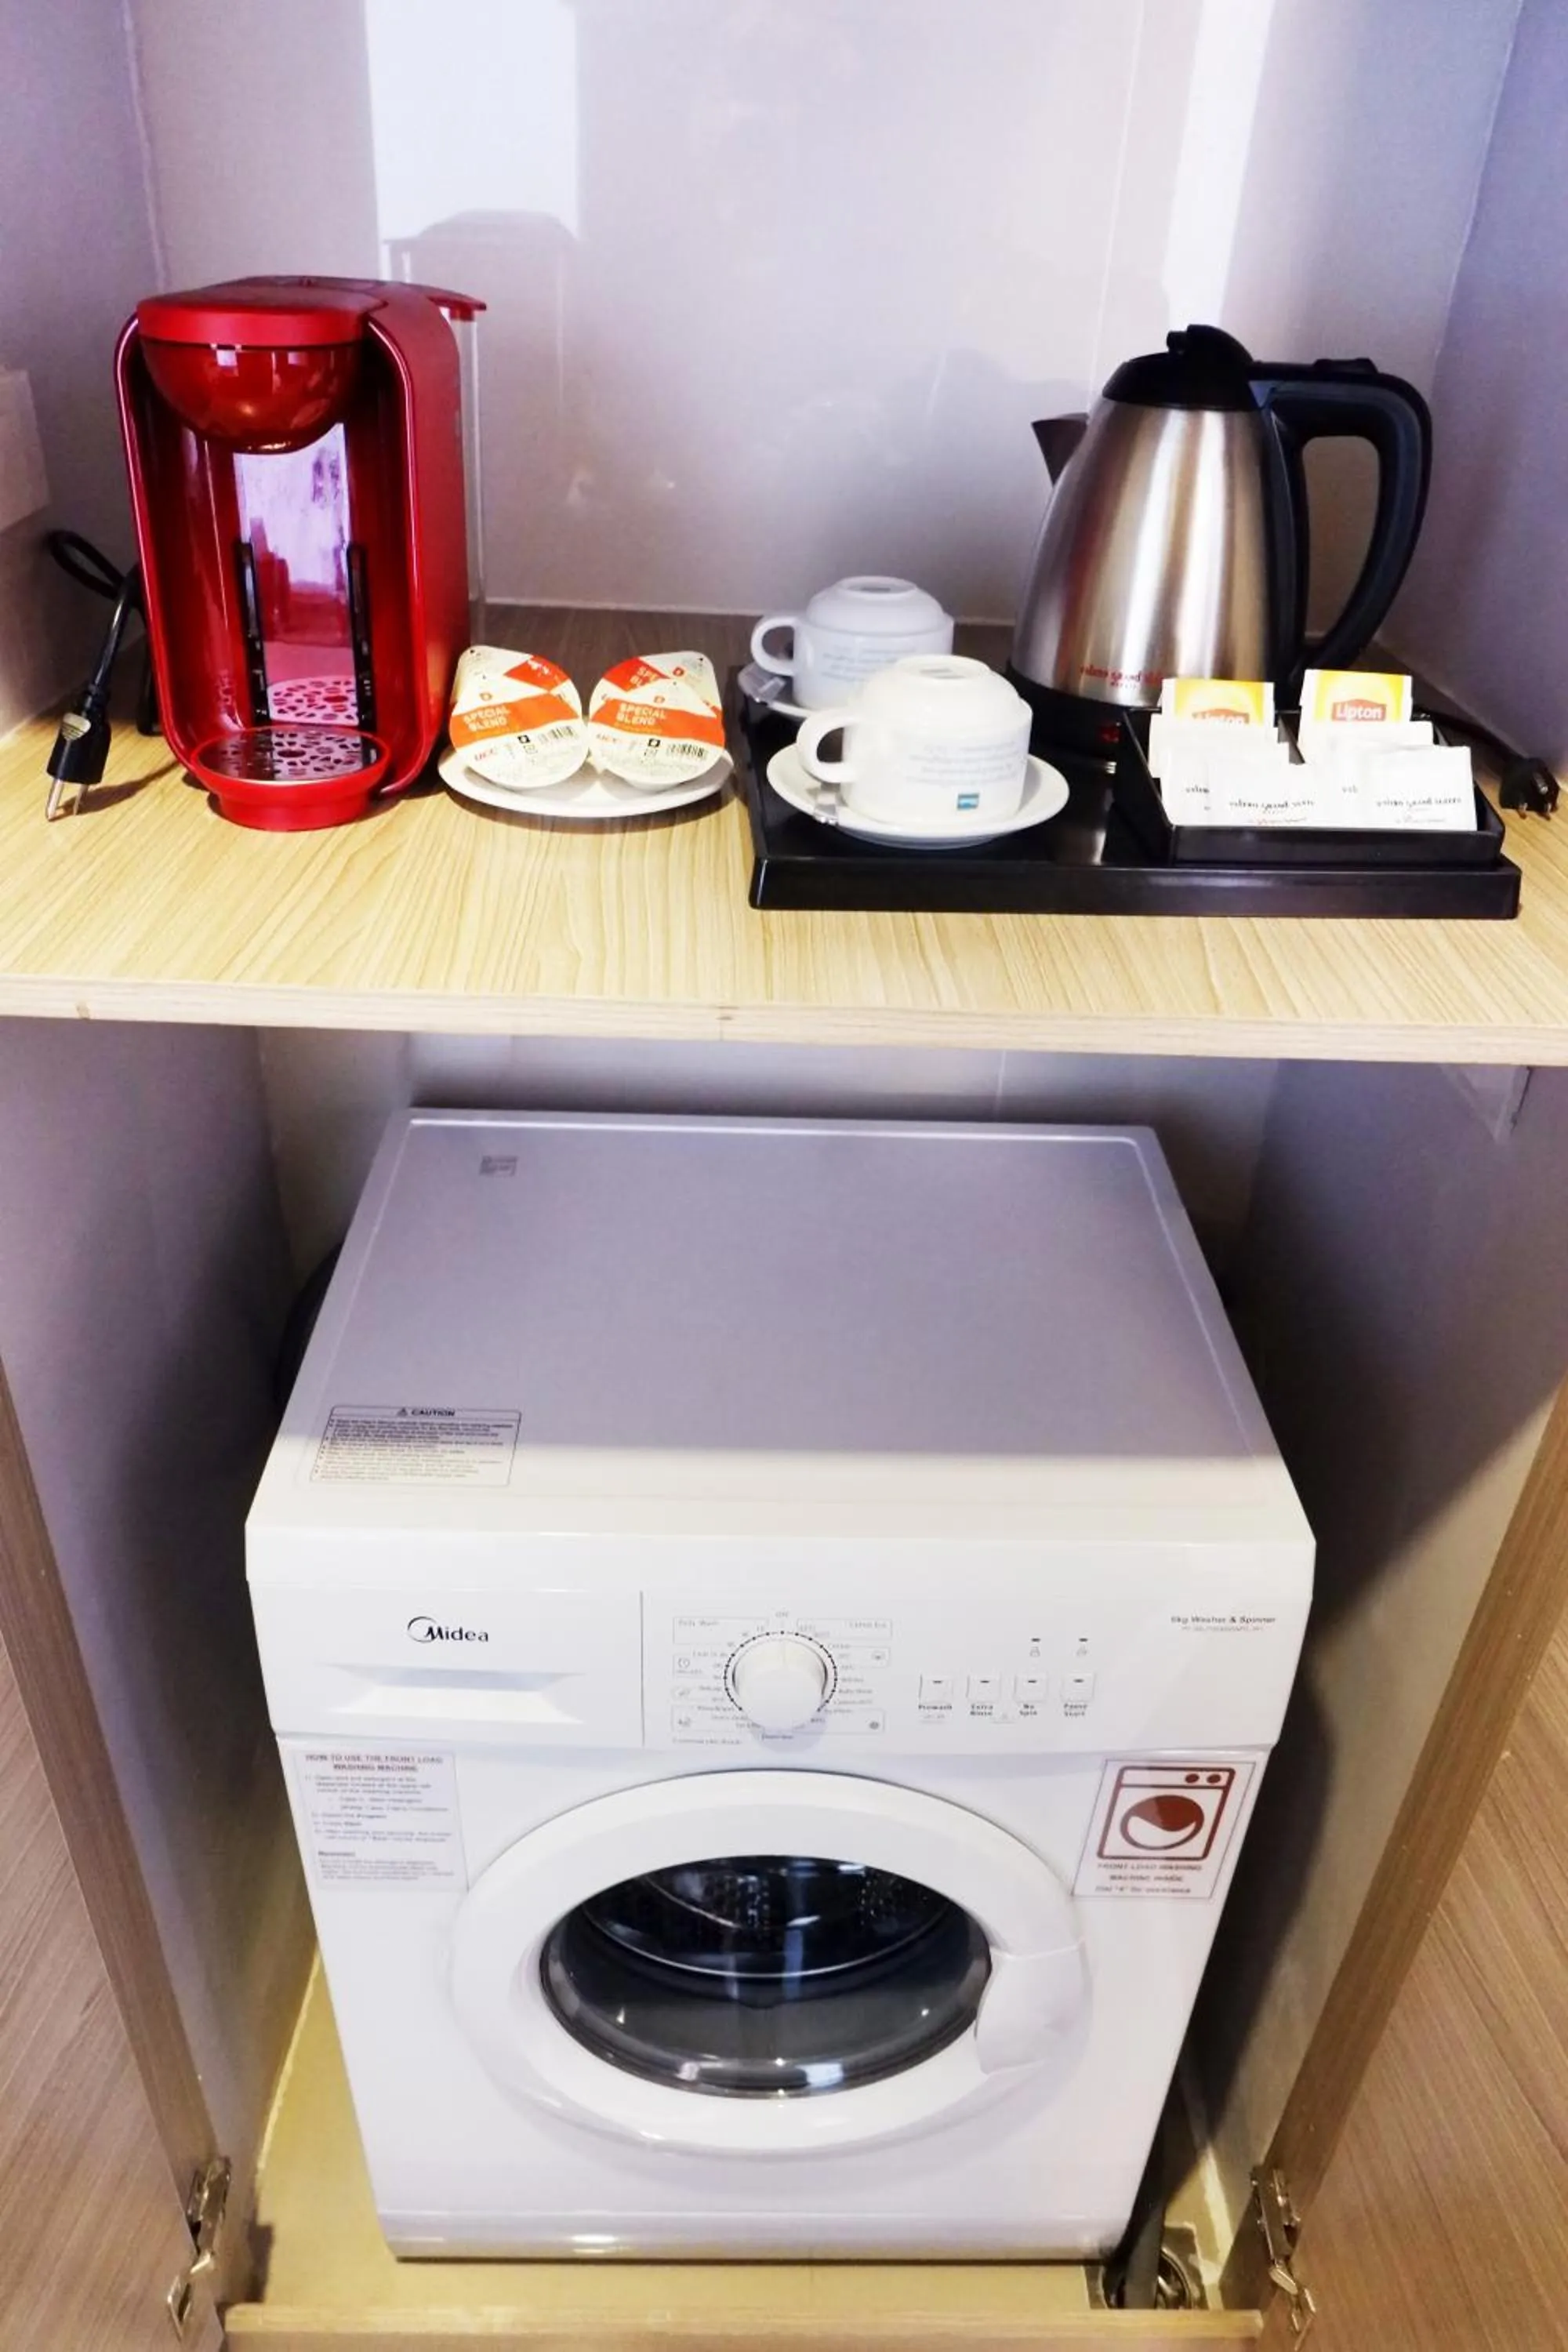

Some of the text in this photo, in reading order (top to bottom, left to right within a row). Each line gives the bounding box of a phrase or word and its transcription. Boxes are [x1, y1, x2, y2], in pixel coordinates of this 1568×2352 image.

[463, 705, 510, 724] SPECIAL
[619, 702, 666, 720] SPECIAL
[1335, 702, 1381, 720] Lipton
[468, 716, 507, 731] BLEND
[615, 713, 656, 726] BLEND
[412, 1407, 456, 1417] CAUTION
